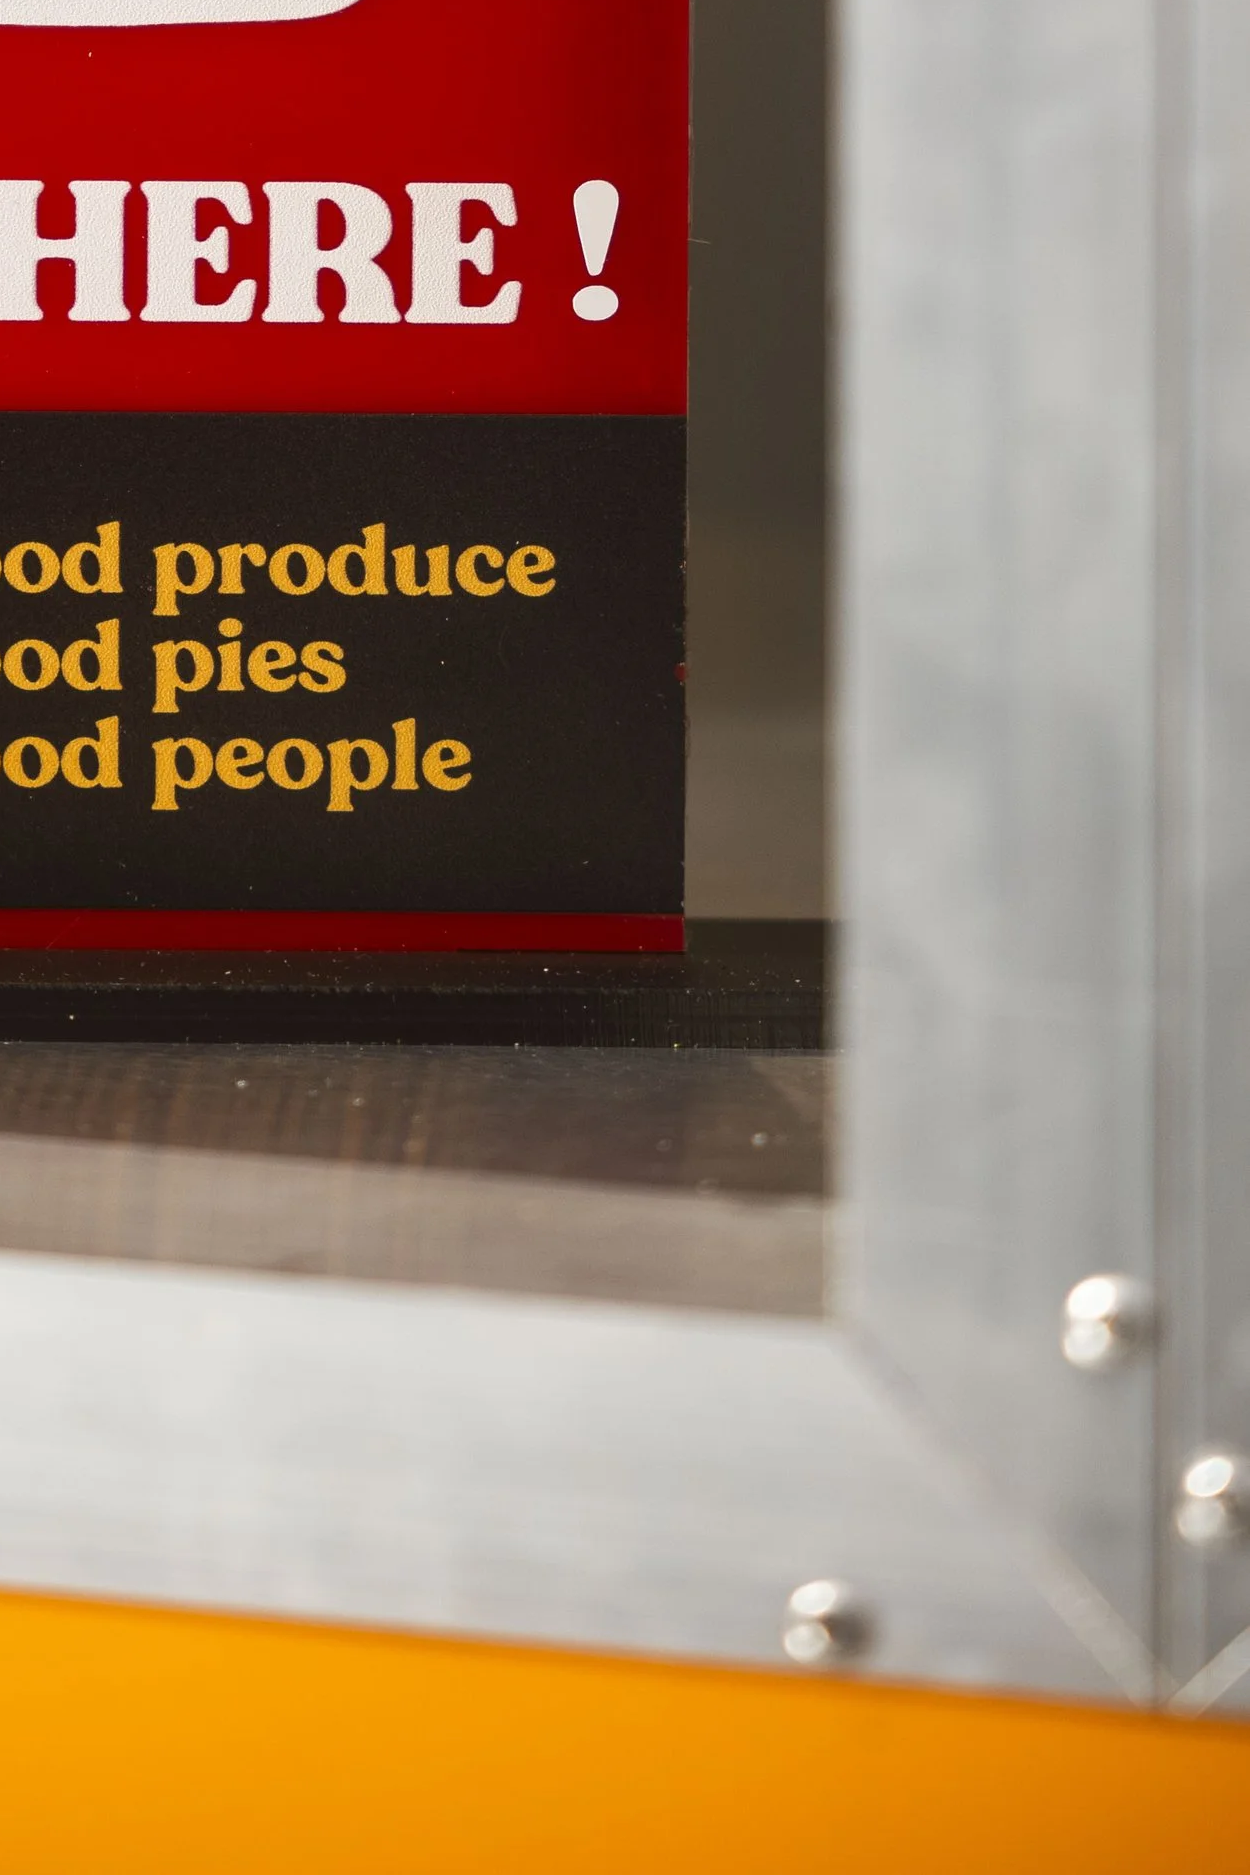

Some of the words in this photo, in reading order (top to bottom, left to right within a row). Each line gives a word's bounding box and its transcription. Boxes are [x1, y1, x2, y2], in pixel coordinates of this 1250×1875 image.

[151, 522, 558, 618] produce
[151, 617, 348, 715] pies
[151, 717, 473, 813] people
